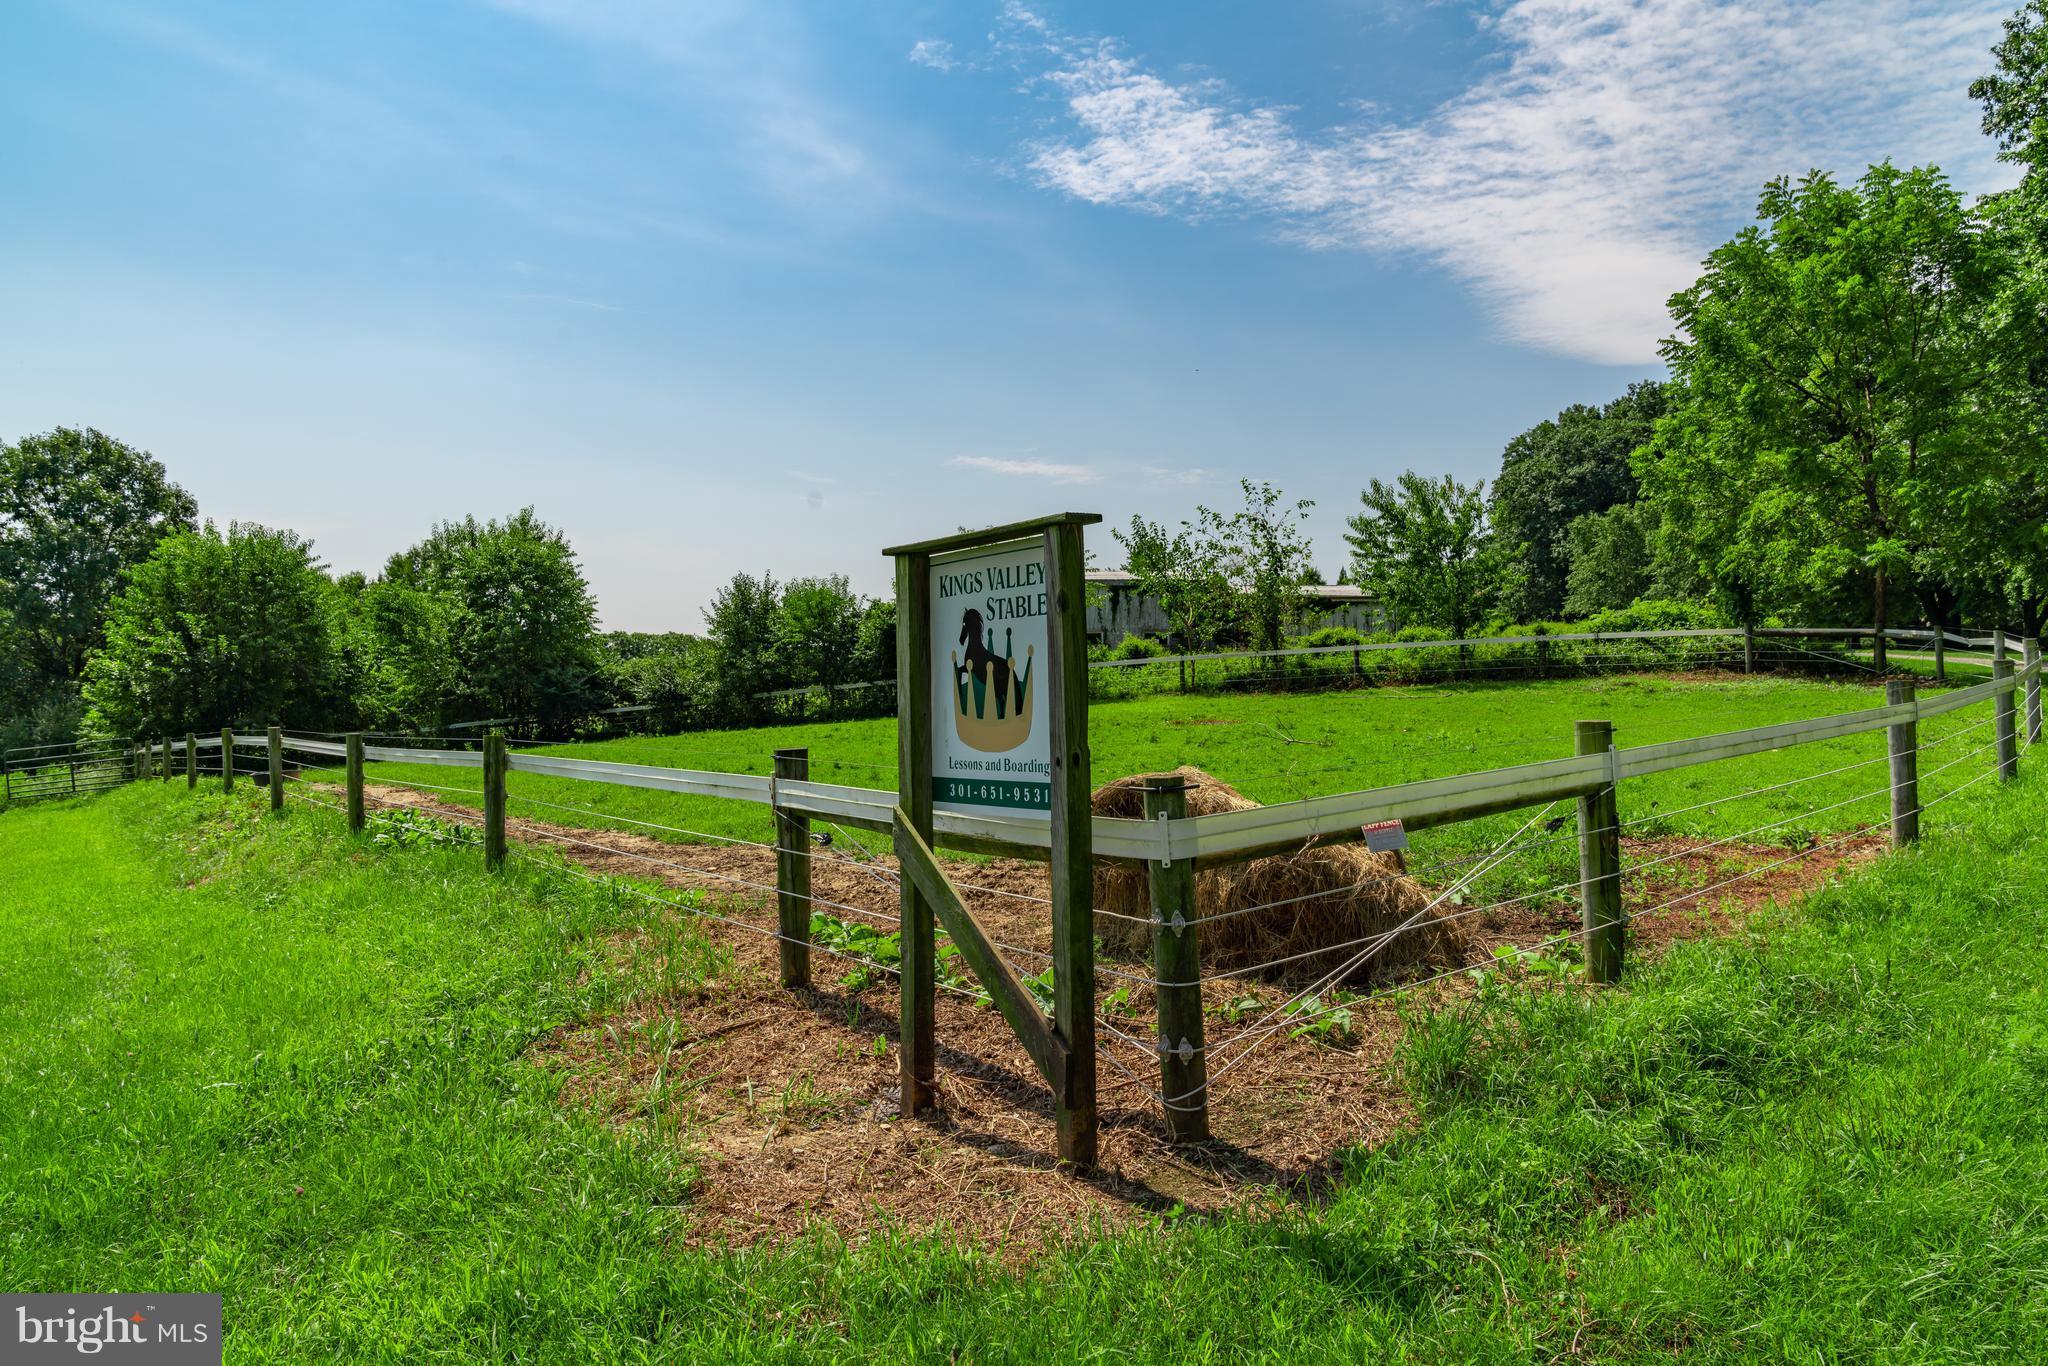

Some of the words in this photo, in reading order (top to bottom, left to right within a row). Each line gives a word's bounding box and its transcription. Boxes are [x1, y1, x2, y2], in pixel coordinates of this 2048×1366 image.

[939, 571, 983, 598] KINGS
[986, 562, 1046, 591] VALLEY
[986, 593, 1048, 621] STABLE
[949, 756, 983, 771] Lessons
[985, 758, 1001, 772] and
[1004, 758, 1050, 777] Boarding
[950, 783, 1049, 803] 301-651-9531
